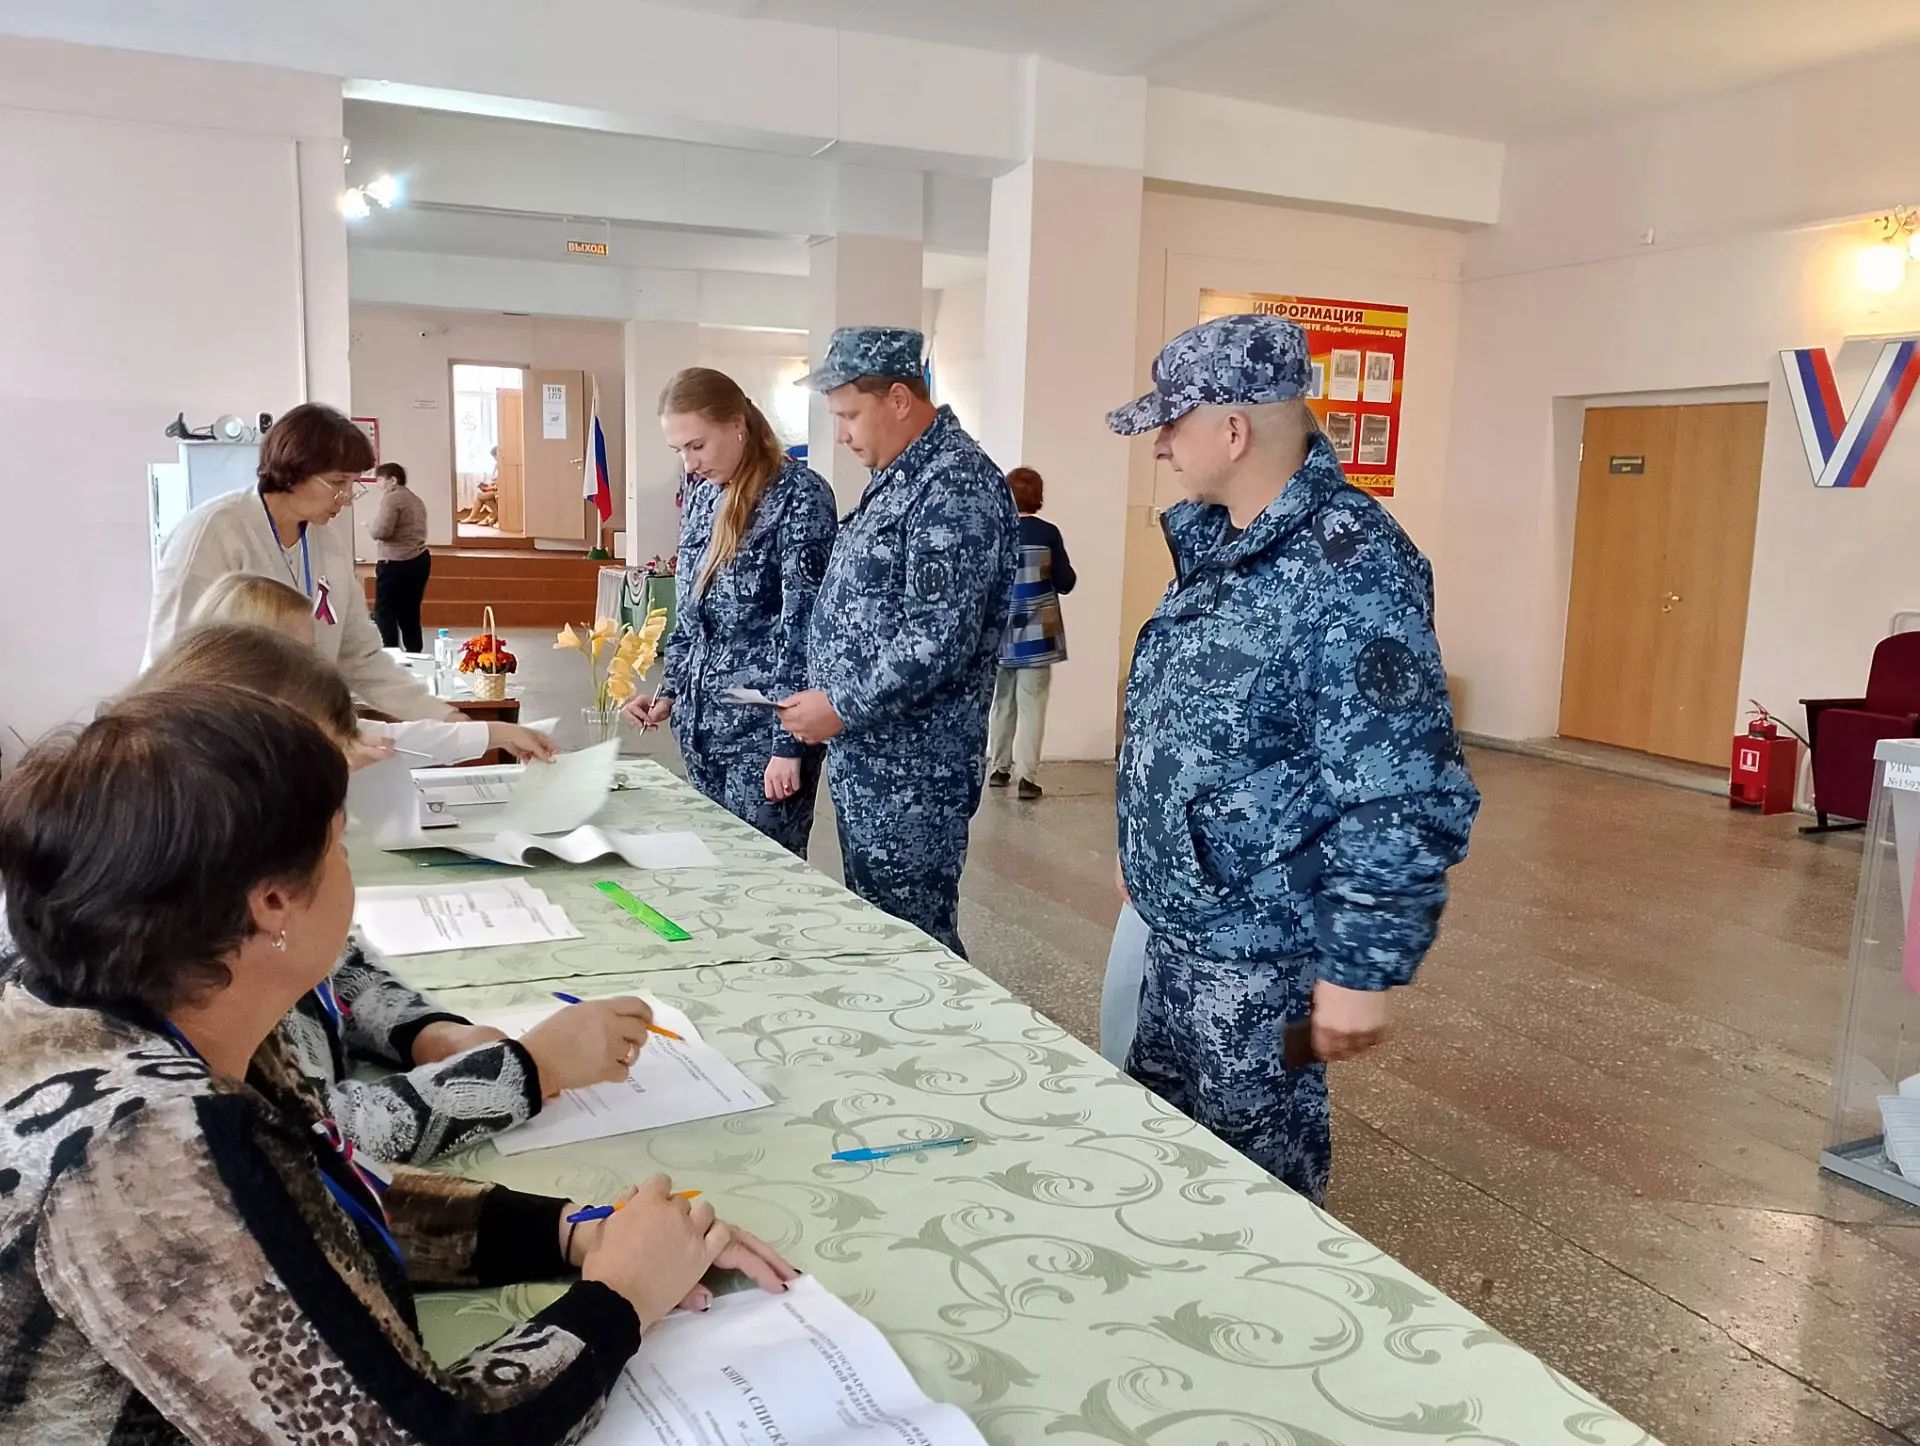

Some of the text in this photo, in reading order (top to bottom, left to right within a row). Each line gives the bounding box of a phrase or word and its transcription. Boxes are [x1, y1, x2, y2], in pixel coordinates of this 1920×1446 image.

[568, 242, 605, 255] ВЫХОД
[1253, 302, 1364, 324] ИНФОРМАЦИЯ
[1890, 761, 1912, 773] УИК
[720, 1365, 754, 1395] КНИГА
